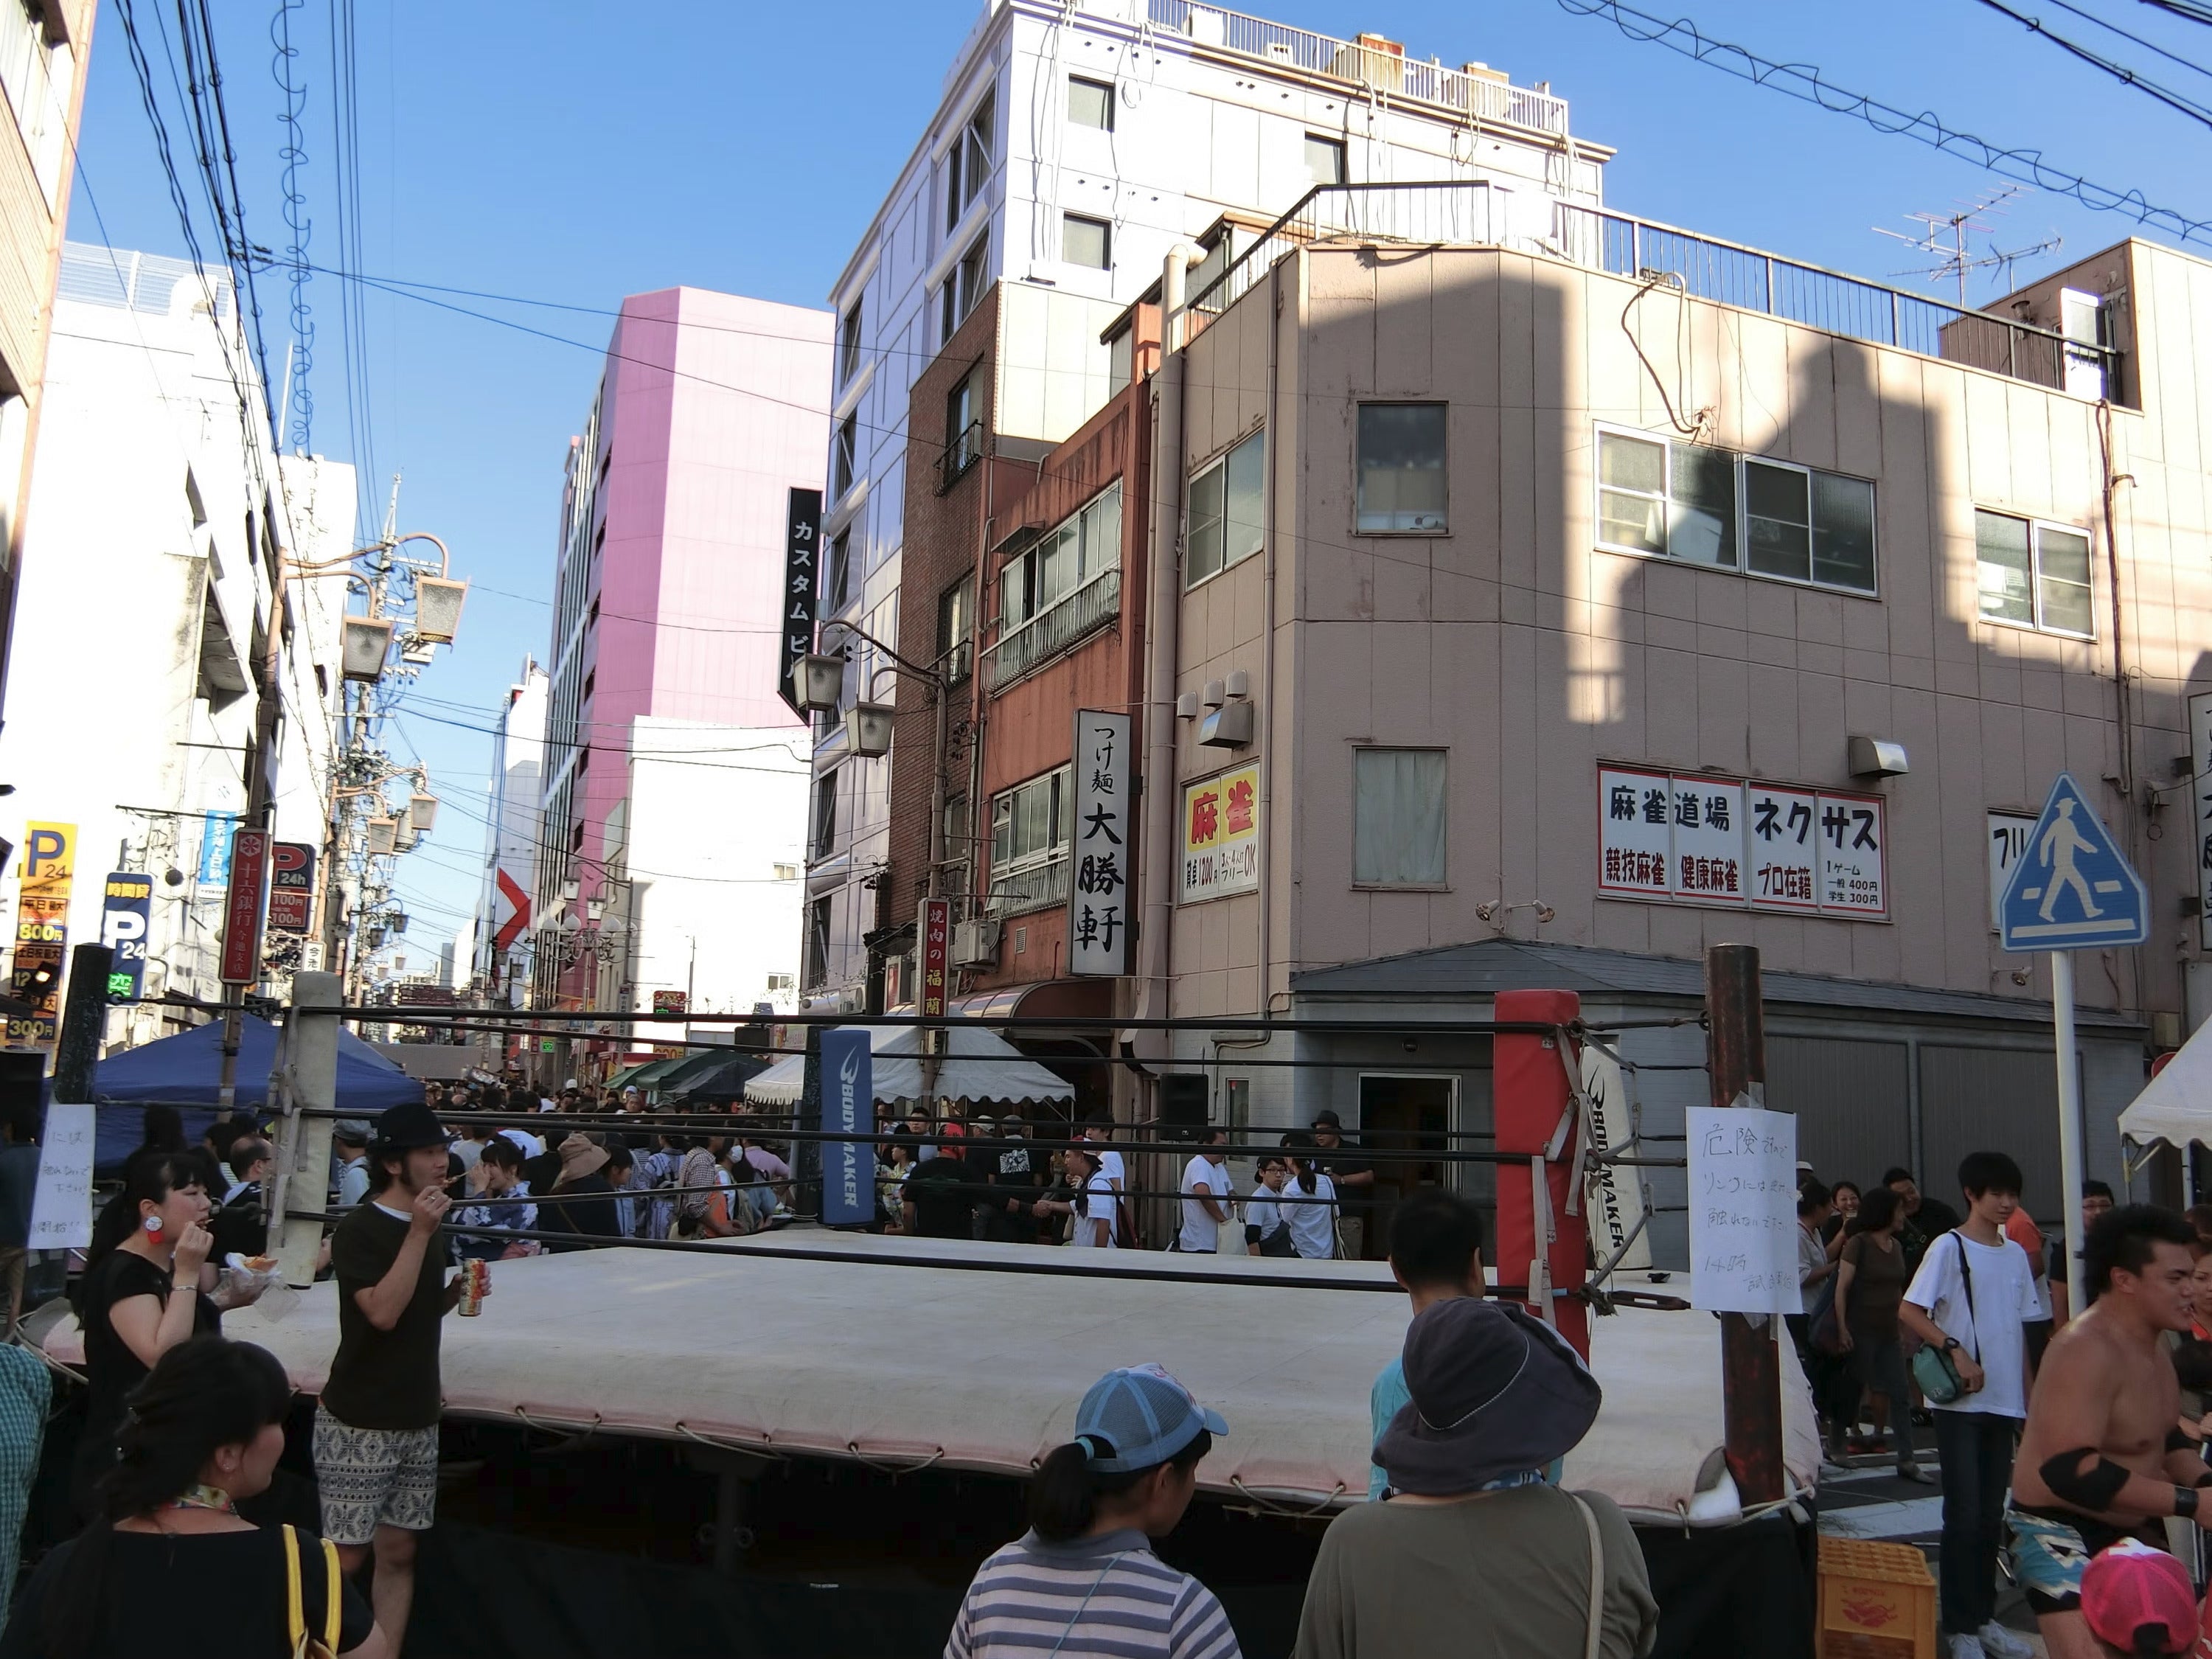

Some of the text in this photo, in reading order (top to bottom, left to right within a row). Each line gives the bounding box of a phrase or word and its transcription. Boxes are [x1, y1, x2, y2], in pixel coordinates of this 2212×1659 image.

[1190, 778, 1254, 845] 麻雀
[1610, 785, 1878, 852] 麻雀道場 ネクサス
[1074, 726, 1125, 953] つけ麺 大勝軒
[27, 829, 66, 877] P
[272, 844, 308, 884] P
[1244, 843, 1256, 877] OK
[44, 863, 66, 879] 24
[280, 872, 307, 886] 24h
[1221, 866, 1244, 882] フリー
[1605, 846, 1812, 900] 競技麻雀 健康麻雀 プロ在籍
[1826, 860, 1861, 876] 1ゲーム
[105, 882, 150, 899] 時間貸
[1827, 877, 1878, 892] 一般 400円
[272, 895, 304, 906] 100円
[1828, 890, 1879, 905] 学生 300円
[233, 862, 258, 974] 十六銀行 今池支店
[271, 913, 302, 925] 100円
[18, 923, 64, 942] 800円
[102, 909, 147, 960] P 24
[307, 947, 319, 972] 今池
[8, 1020, 54, 1037] 300円
[1593, 1110, 1625, 1249] BODMAKER
